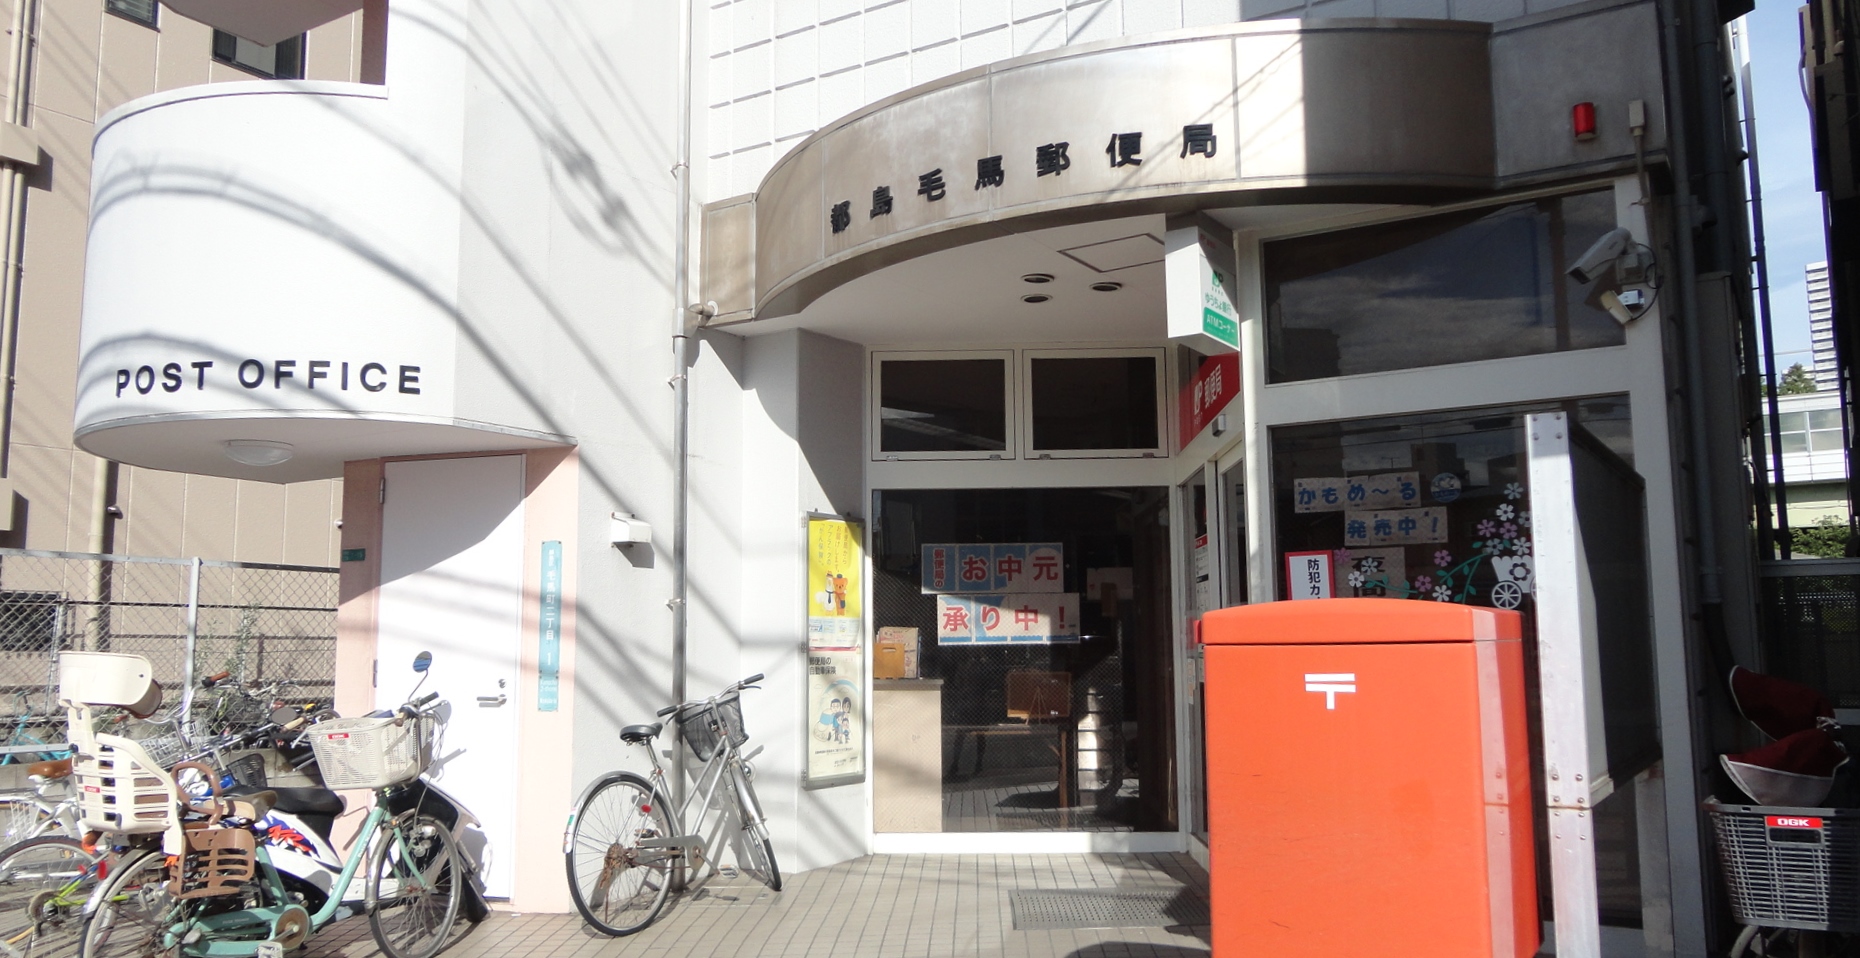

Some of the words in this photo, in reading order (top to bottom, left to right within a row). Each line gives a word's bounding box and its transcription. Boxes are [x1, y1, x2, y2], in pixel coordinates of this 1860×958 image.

[831, 123, 1217, 234] 都島毛馬郵便局
[1205, 292, 1232, 316] ゆうちょ銀行
[1206, 313, 1235, 334] ATMコーナー
[116, 360, 214, 398] POST
[238, 358, 421, 395] OFFICE
[1204, 363, 1222, 409] 郵便局
[1346, 516, 1439, 540] 発売中！
[933, 548, 945, 588] 郵便局の
[962, 555, 1059, 582] お中元
[1307, 558, 1321, 599] 防犯カ
[545, 570, 556, 640] 毛馬町二丁目
[942, 604, 1066, 632] 承り中！
[809, 656, 832, 666] 郵便局の
[809, 665, 837, 676] 自動車保険
[1777, 818, 1810, 827] OGK
